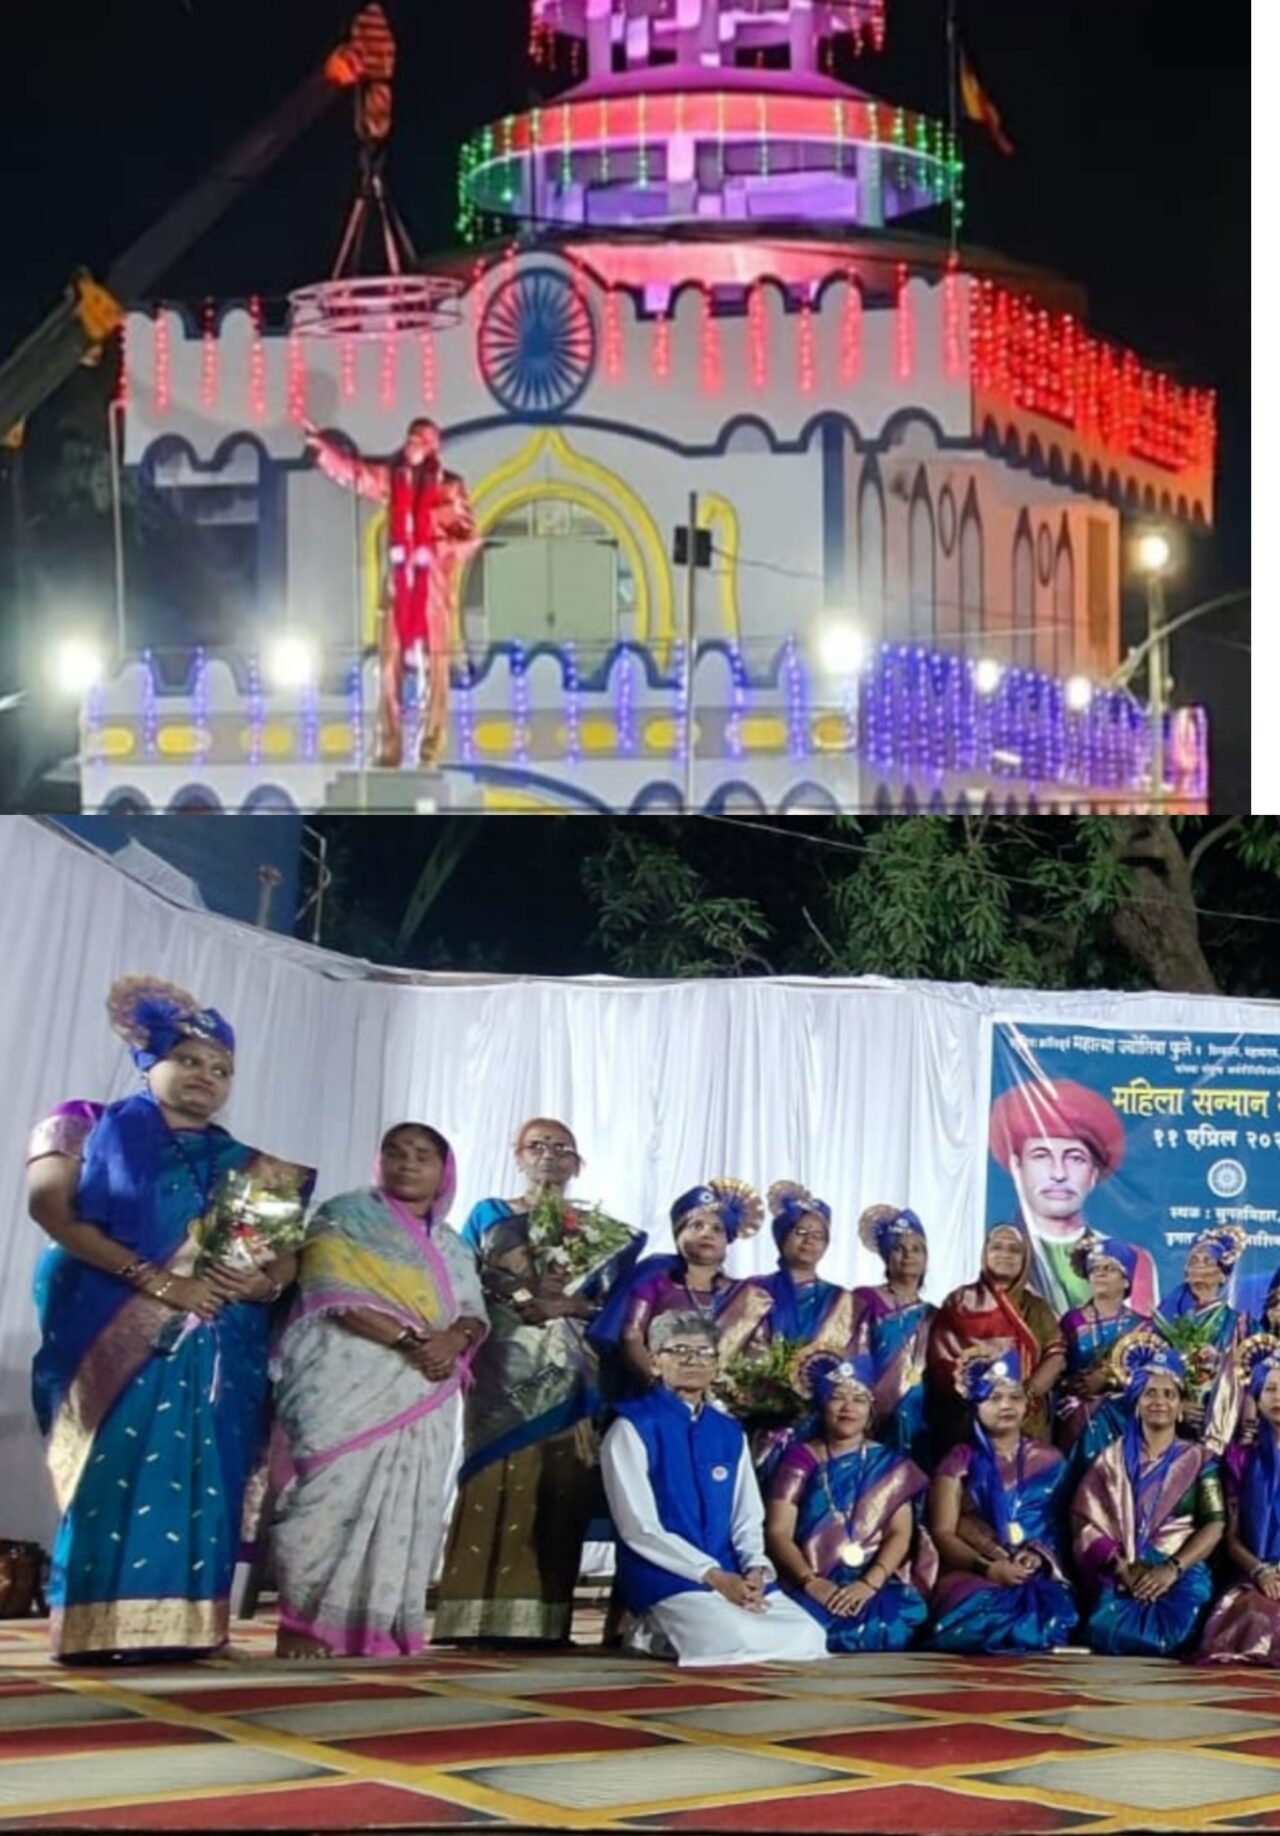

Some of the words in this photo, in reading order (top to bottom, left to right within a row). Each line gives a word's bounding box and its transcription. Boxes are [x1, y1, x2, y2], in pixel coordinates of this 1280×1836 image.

[1073, 1035, 1115, 1054] महात्मा
[1169, 1035, 1193, 1062] फुले
[1111, 1077, 1185, 1116] महिला
[1191, 1087, 1270, 1118] सन्मान
[1153, 1128, 1178, 1149] ११
[1185, 1122, 1238, 1152] एप्रिल
